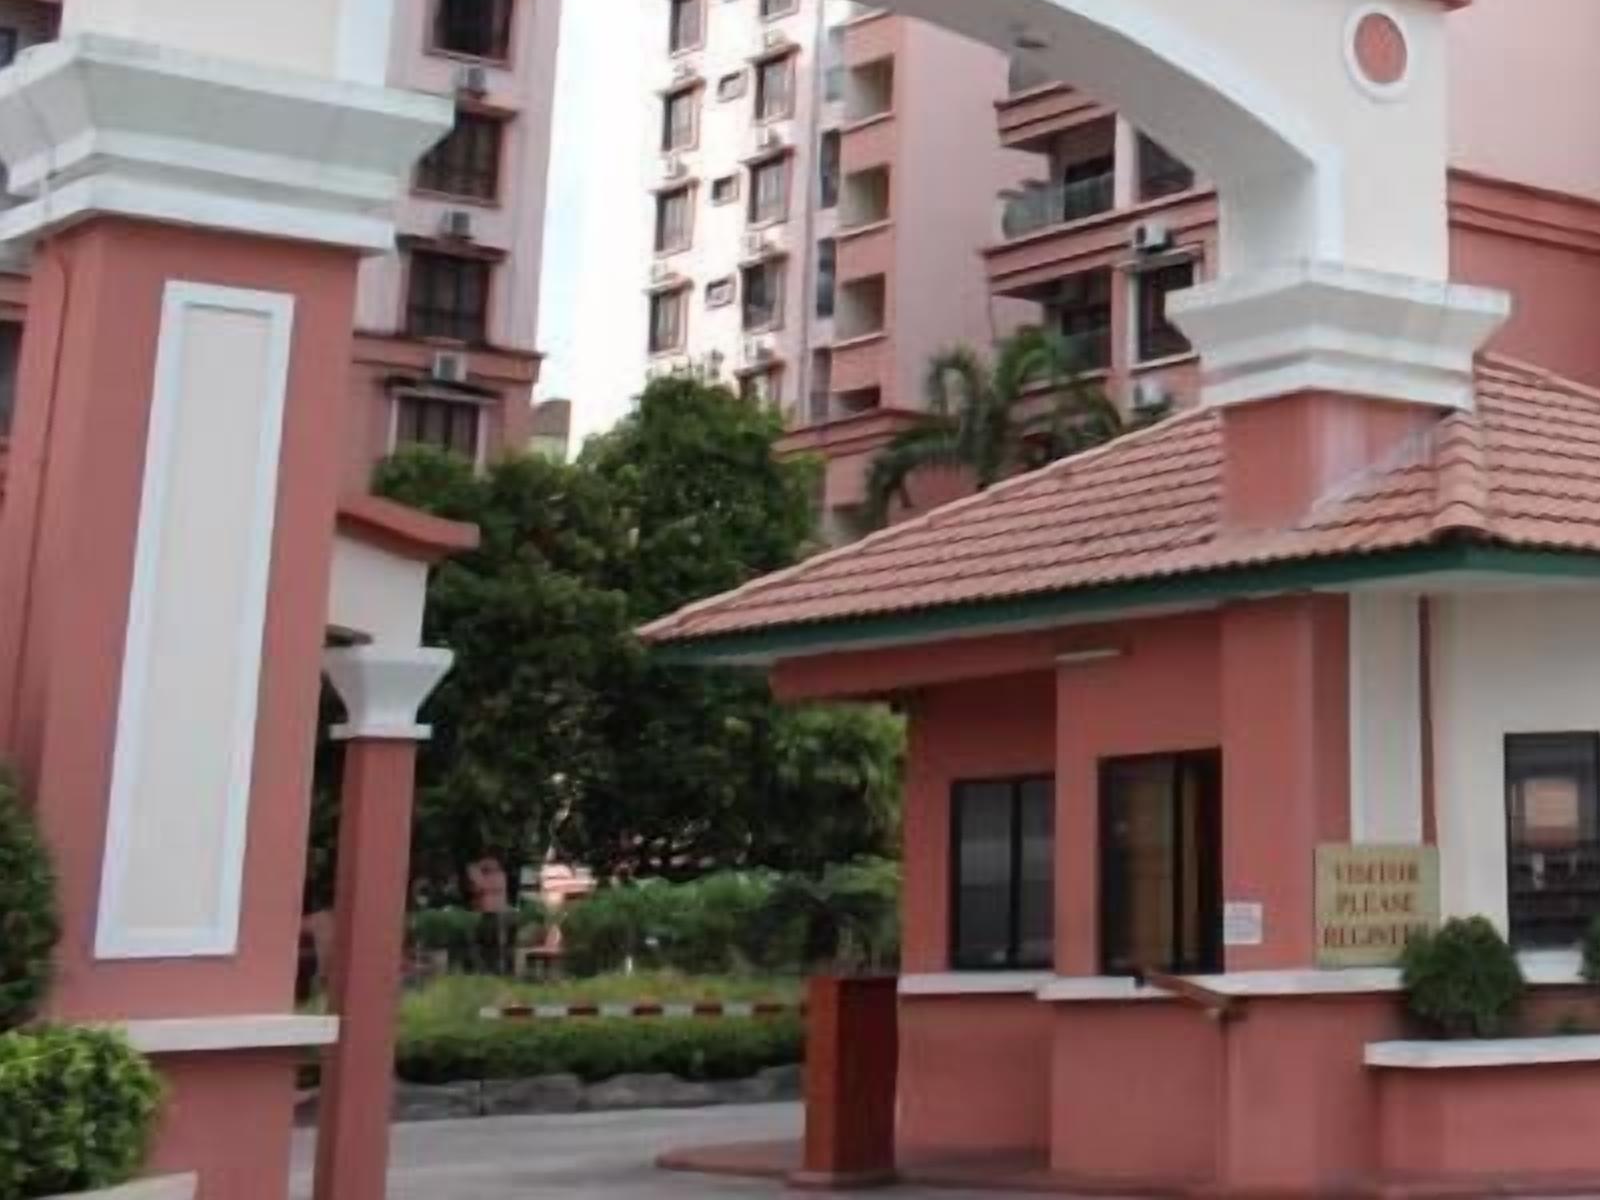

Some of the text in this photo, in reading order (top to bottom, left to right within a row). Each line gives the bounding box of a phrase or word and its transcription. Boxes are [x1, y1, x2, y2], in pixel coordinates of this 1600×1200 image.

[1334, 860, 1420, 883] VISITOR
[1335, 890, 1413, 914] PLEASE
[1323, 921, 1428, 948] REGISTE
